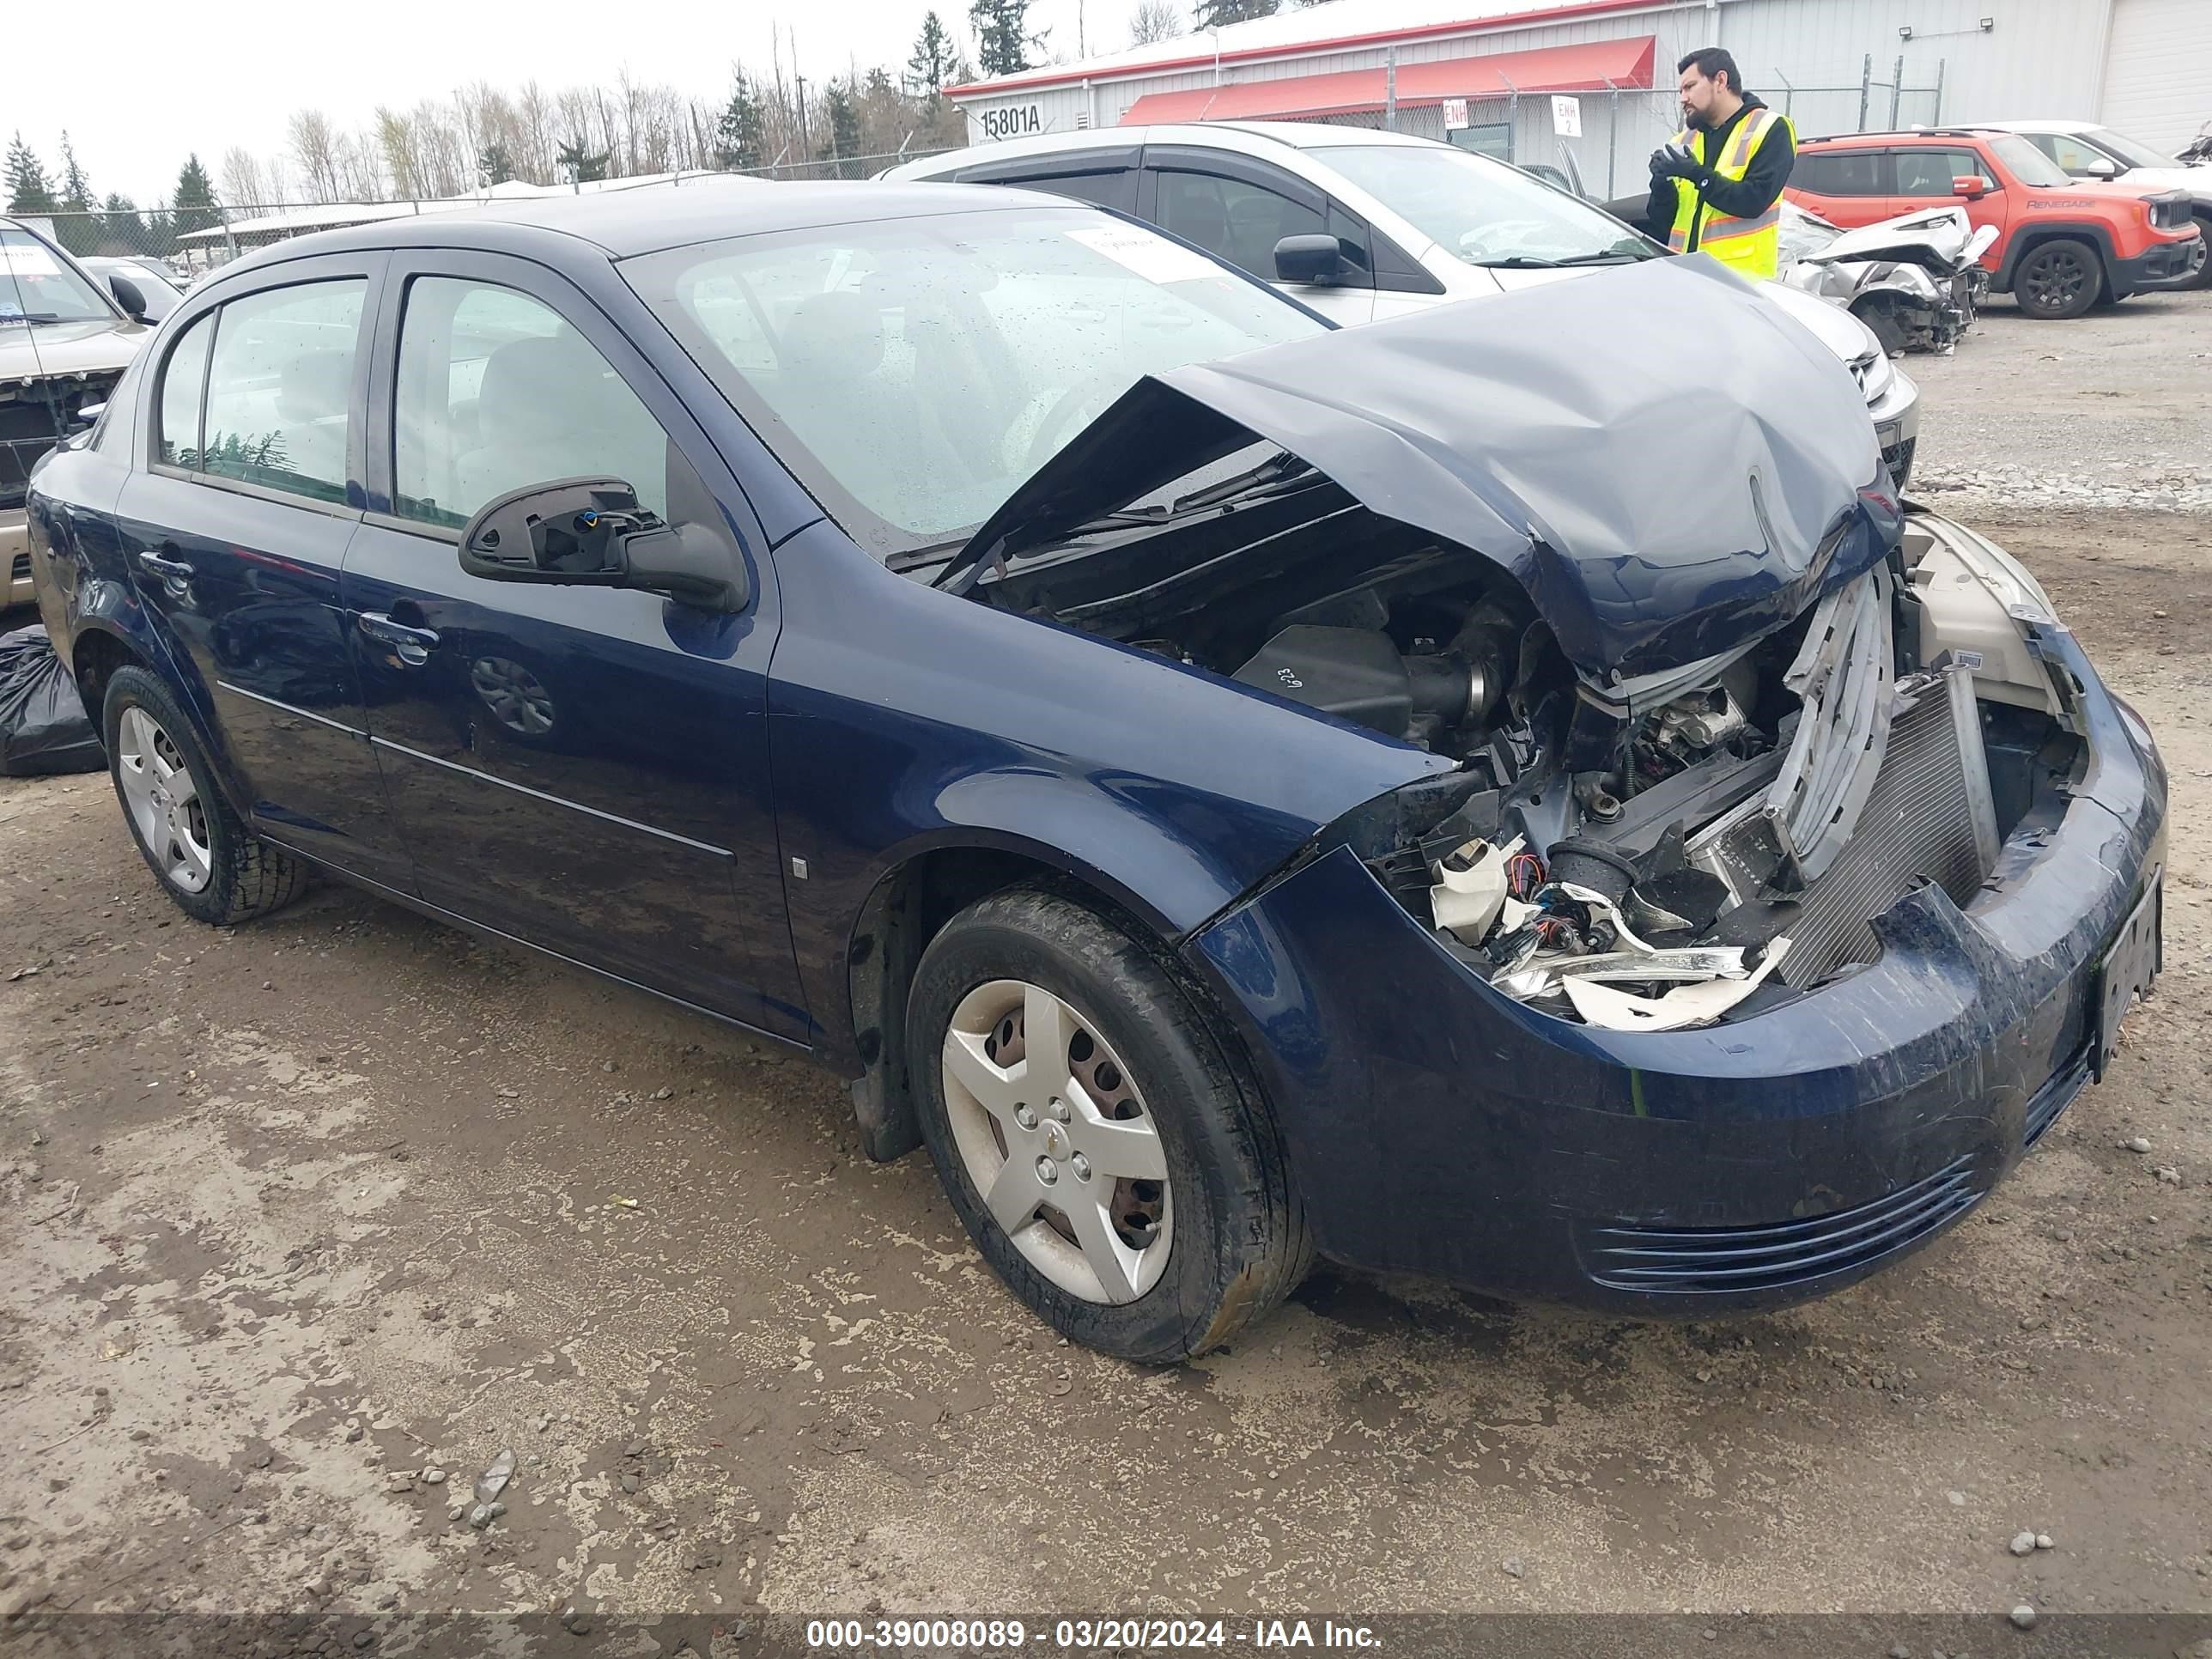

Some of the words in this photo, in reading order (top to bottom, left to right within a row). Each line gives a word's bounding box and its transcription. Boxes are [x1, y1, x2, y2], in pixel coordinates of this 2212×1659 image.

[981, 105, 1041, 137] 15801A
[1445, 105, 1468, 125] ENH
[2027, 200, 2096, 210] RENEGADE
